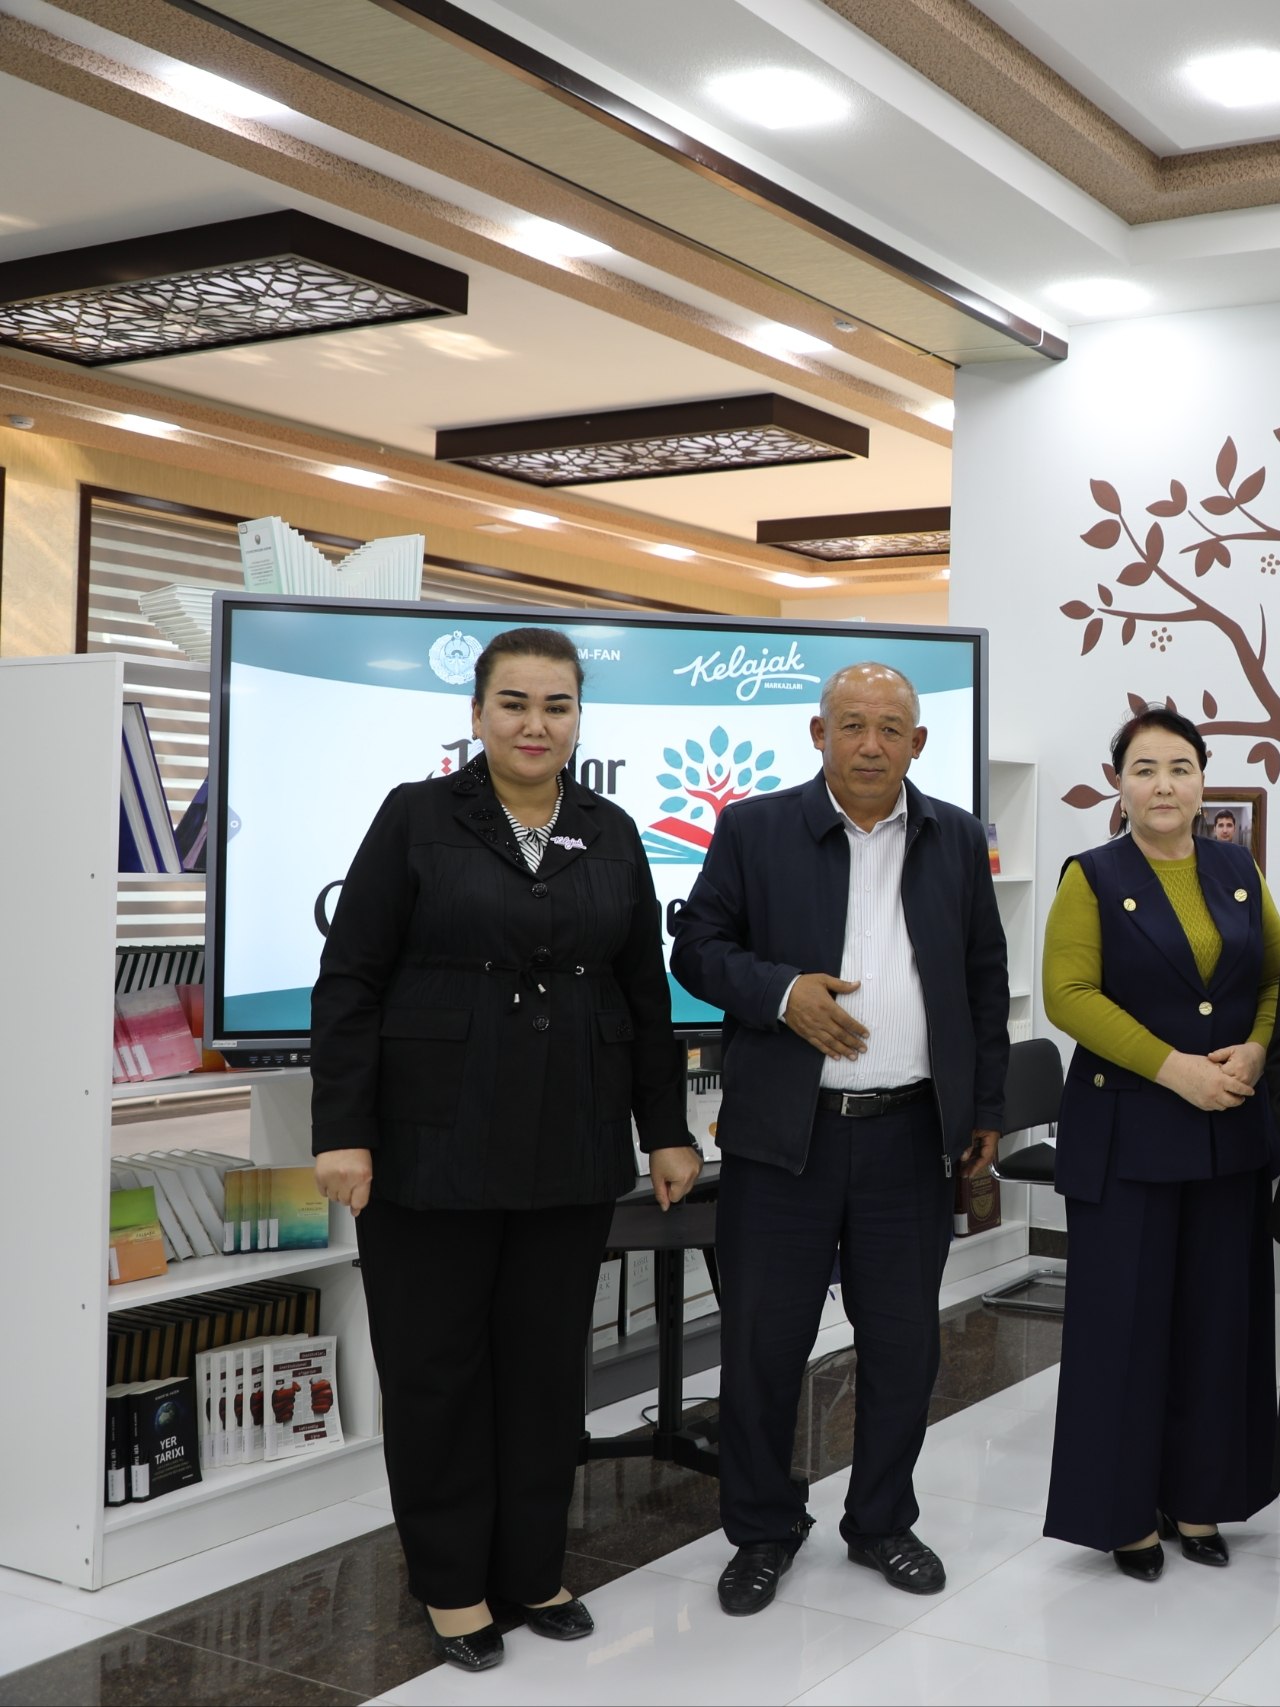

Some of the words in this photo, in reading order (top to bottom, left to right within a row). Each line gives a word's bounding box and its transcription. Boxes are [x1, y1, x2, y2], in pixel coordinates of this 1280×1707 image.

[673, 641, 821, 701] Kelajak
[764, 682, 803, 690] MARKAZLARI
[160, 1435, 177, 1450] YER
[154, 1445, 185, 1465] TARIXI
